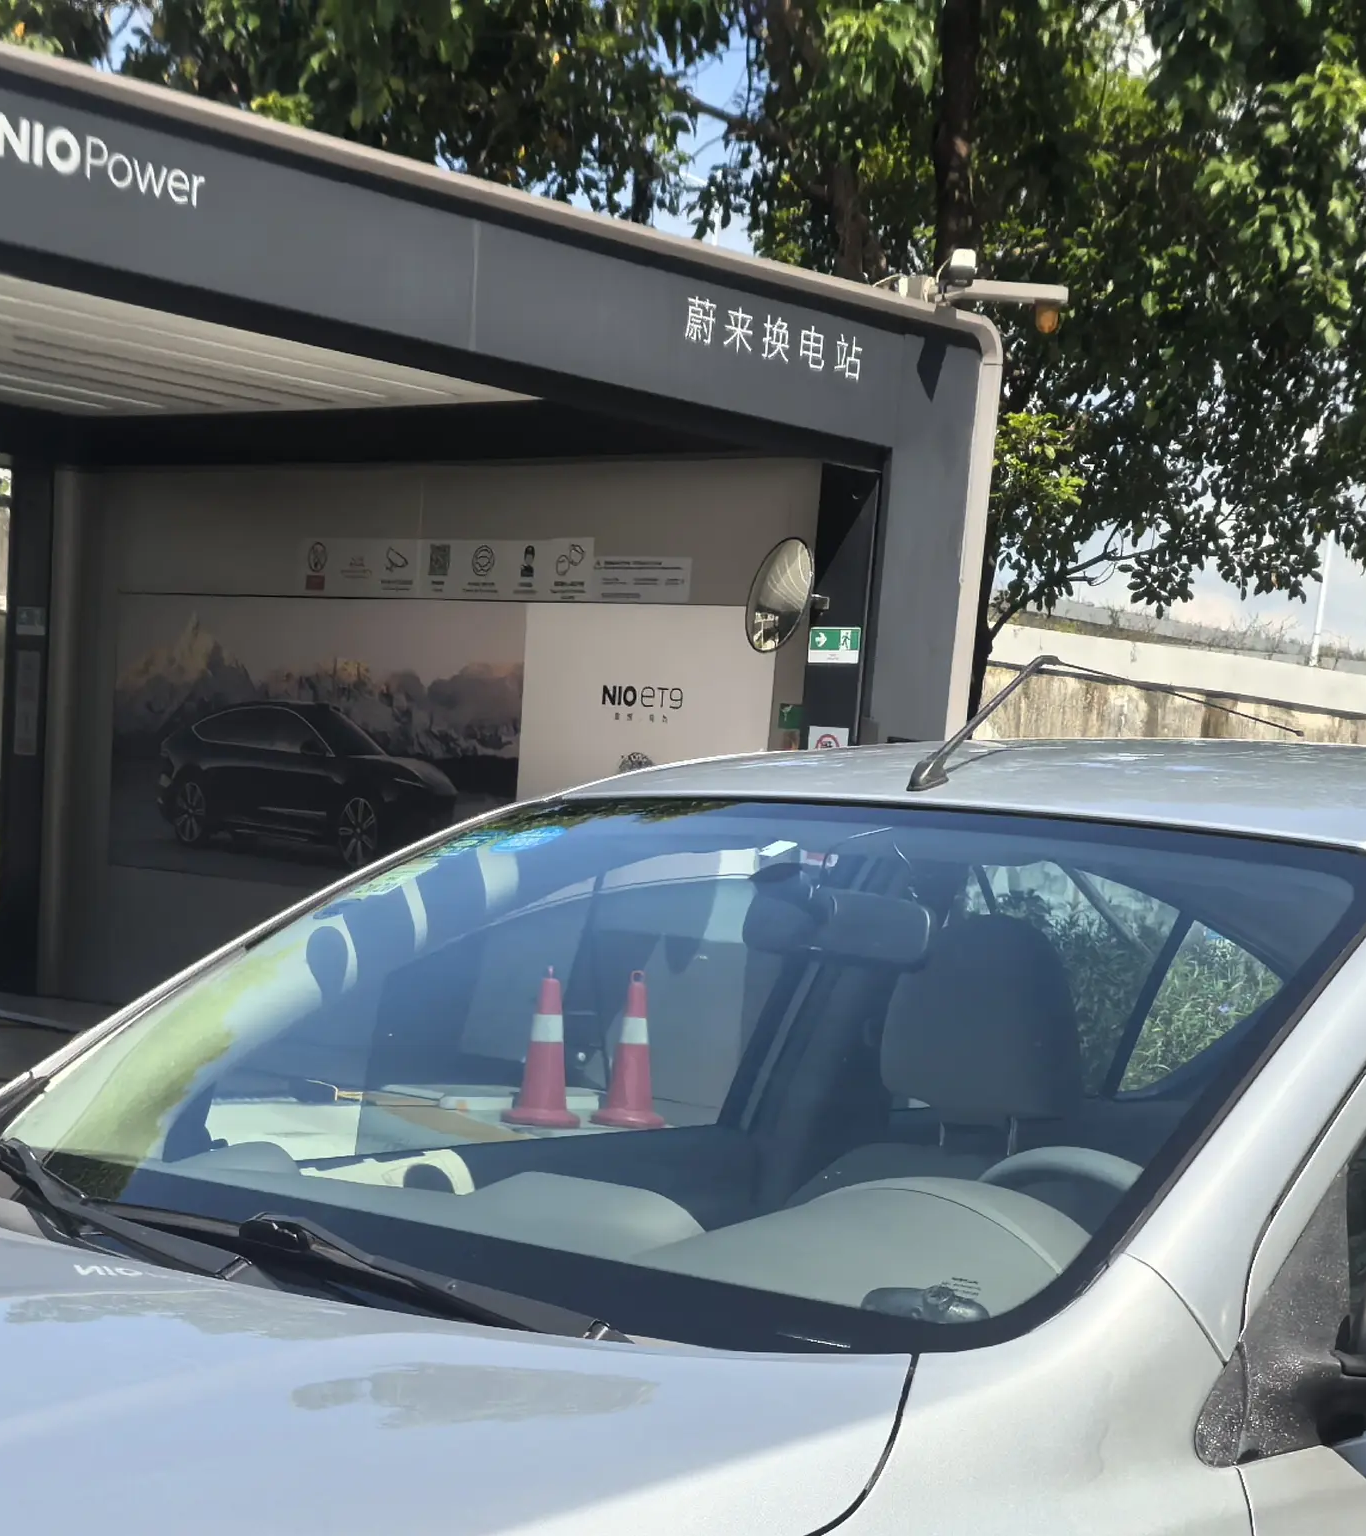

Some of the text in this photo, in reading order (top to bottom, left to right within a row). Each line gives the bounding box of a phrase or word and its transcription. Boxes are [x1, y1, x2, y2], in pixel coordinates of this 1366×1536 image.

[684, 295, 863, 382] 蔚来换电站
